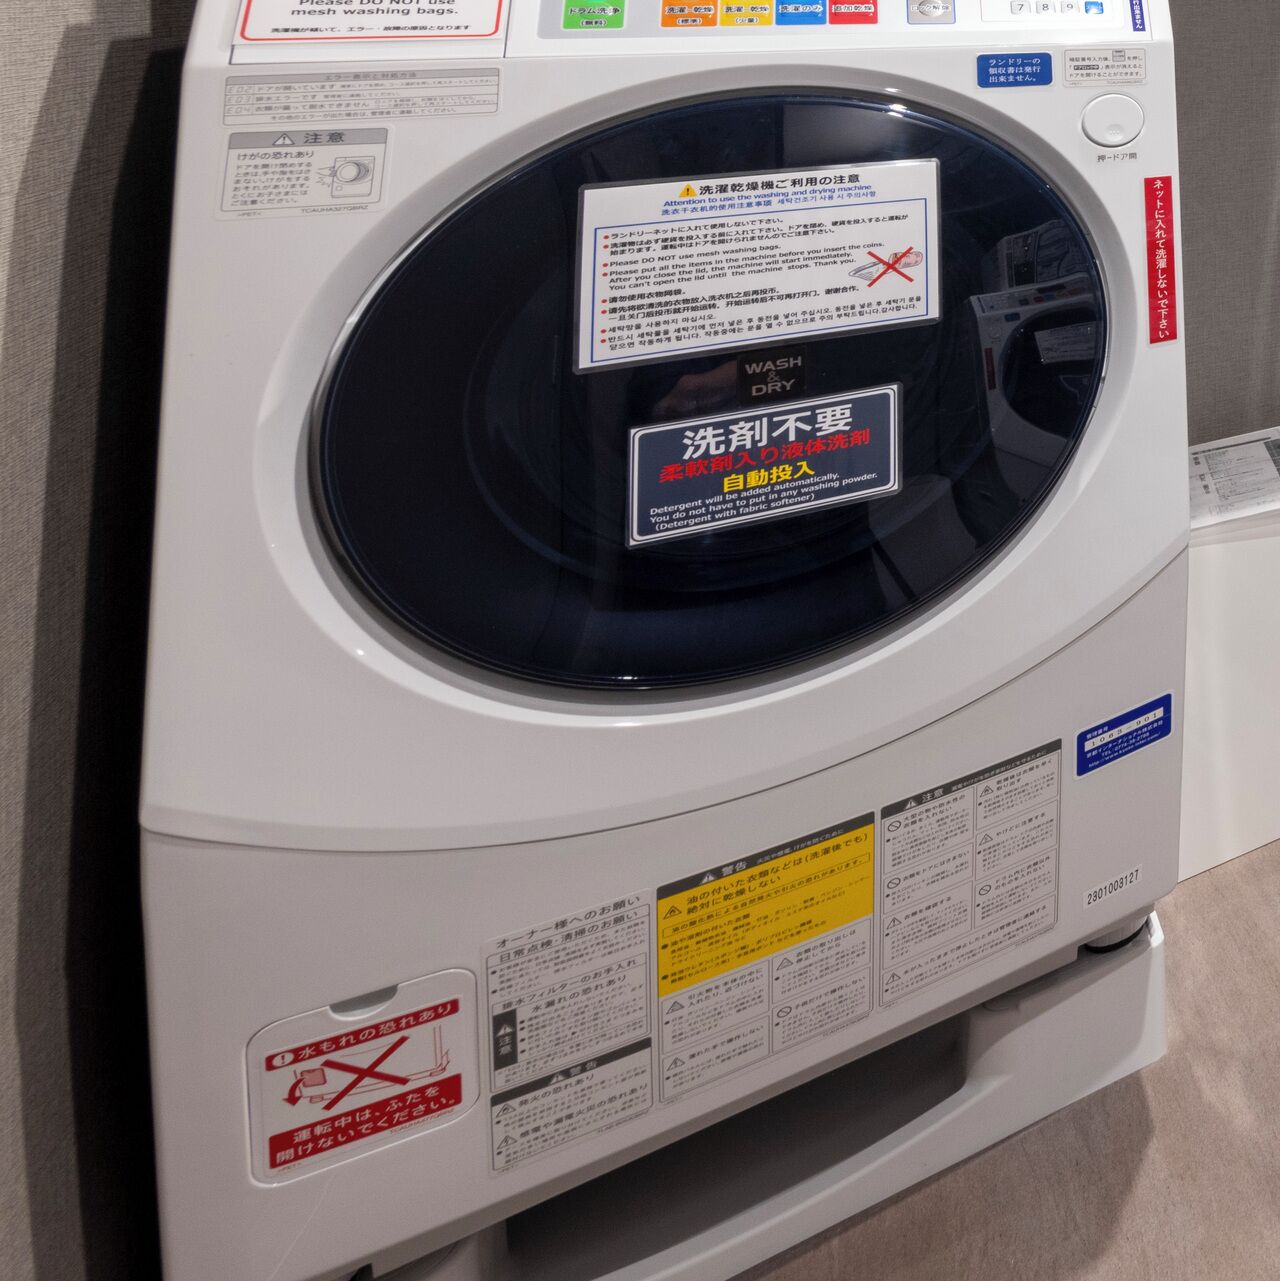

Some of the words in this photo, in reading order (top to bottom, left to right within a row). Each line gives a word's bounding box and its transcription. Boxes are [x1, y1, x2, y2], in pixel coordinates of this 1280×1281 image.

[291, 8, 336, 16] mesh
[343, 6, 410, 16] washing
[417, 6, 458, 16] bags.
[568, 6, 620, 16] ドラム洗浄
[911, 4, 950, 12] ロック解除
[989, 66, 1041, 74] 領収書は発行
[989, 75, 1037, 83] 出来ません。
[303, 132, 344, 144] 注意
[237, 151, 315, 161] けがの恐れあり
[664, 195, 705, 207] Attention
[737, 193, 751, 201] the
[754, 191, 789, 199] washing
[810, 186, 835, 195] drying
[838, 184, 872, 192] machine
[699, 174, 860, 195] 洗濯乾燥機ご利用の注意
[611, 218, 784, 240] ランドリーネットに入れて使用しないで下さい。
[641, 266, 656, 274] put
[742, 253, 776, 261] machine
[779, 250, 805, 258] before
[697, 250, 720, 258] mesh
[723, 246, 757, 256] washing
[1153, 179, 1170, 340] ネットに入れて洗濯しないで下さい
[744, 356, 802, 375] WASH
[752, 378, 796, 397] DRY
[767, 372, 781, 383] &
[682, 403, 853, 460] 洗剤不要
[658, 428, 871, 484] 柔軟剤入り液体洗剤
[723, 461, 815, 493] 自動投入
[650, 500, 702, 515] Detergent
[706, 495, 723, 504] will
[740, 485, 771, 498] added
[774, 473, 840, 491] automatically.
[650, 515, 669, 523] You
[689, 507, 706, 516] not
[709, 502, 733, 512] have
[749, 494, 766, 505] put
[781, 489, 798, 498] any
[801, 480, 840, 493] washing
[842, 473, 877, 485] powder.
[655, 514, 711, 531] (Detergent
[715, 509, 736, 519] with
[739, 503, 768, 515] fabric
[771, 493, 814, 507] softener)
[921, 788, 944, 803] 注意
[722, 860, 748, 876] 警告
[686, 876, 781, 915] 絶対に乾燥しない
[1087, 869, 1139, 905] 2301003127
[497, 896, 640, 949] オーナー様へのお願い
[299, 1001, 453, 1060] 水もれの恐れあり
[293, 1087, 440, 1143] 運転中は、ふたを
[276, 1097, 456, 1164] 開けないでください。
